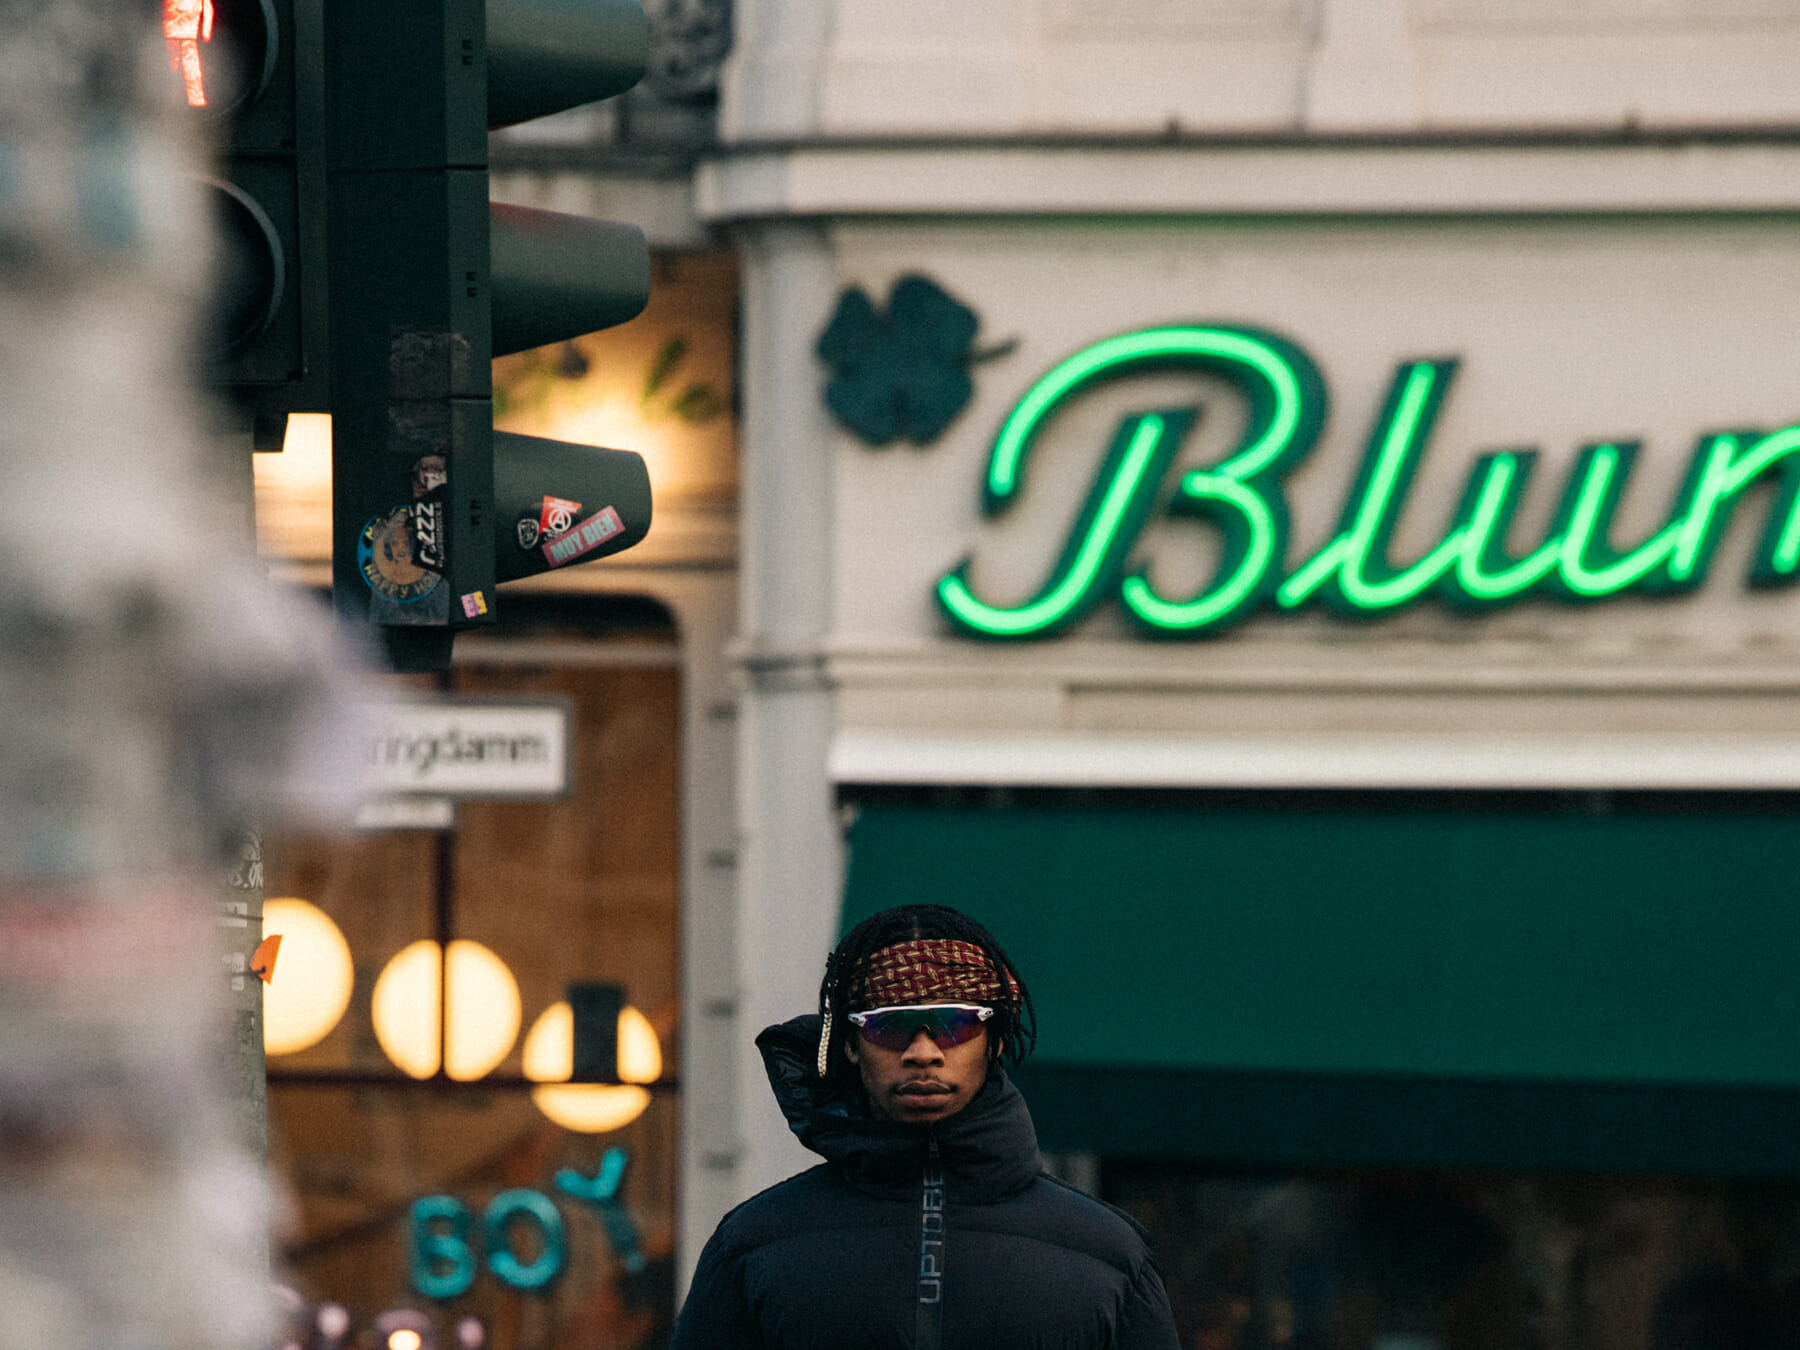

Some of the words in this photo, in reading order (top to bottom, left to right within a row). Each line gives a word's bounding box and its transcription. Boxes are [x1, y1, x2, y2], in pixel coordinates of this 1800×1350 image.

[550, 531, 584, 562] MUY
[581, 512, 617, 546] BIEN
[363, 564, 409, 599] HAPPY
